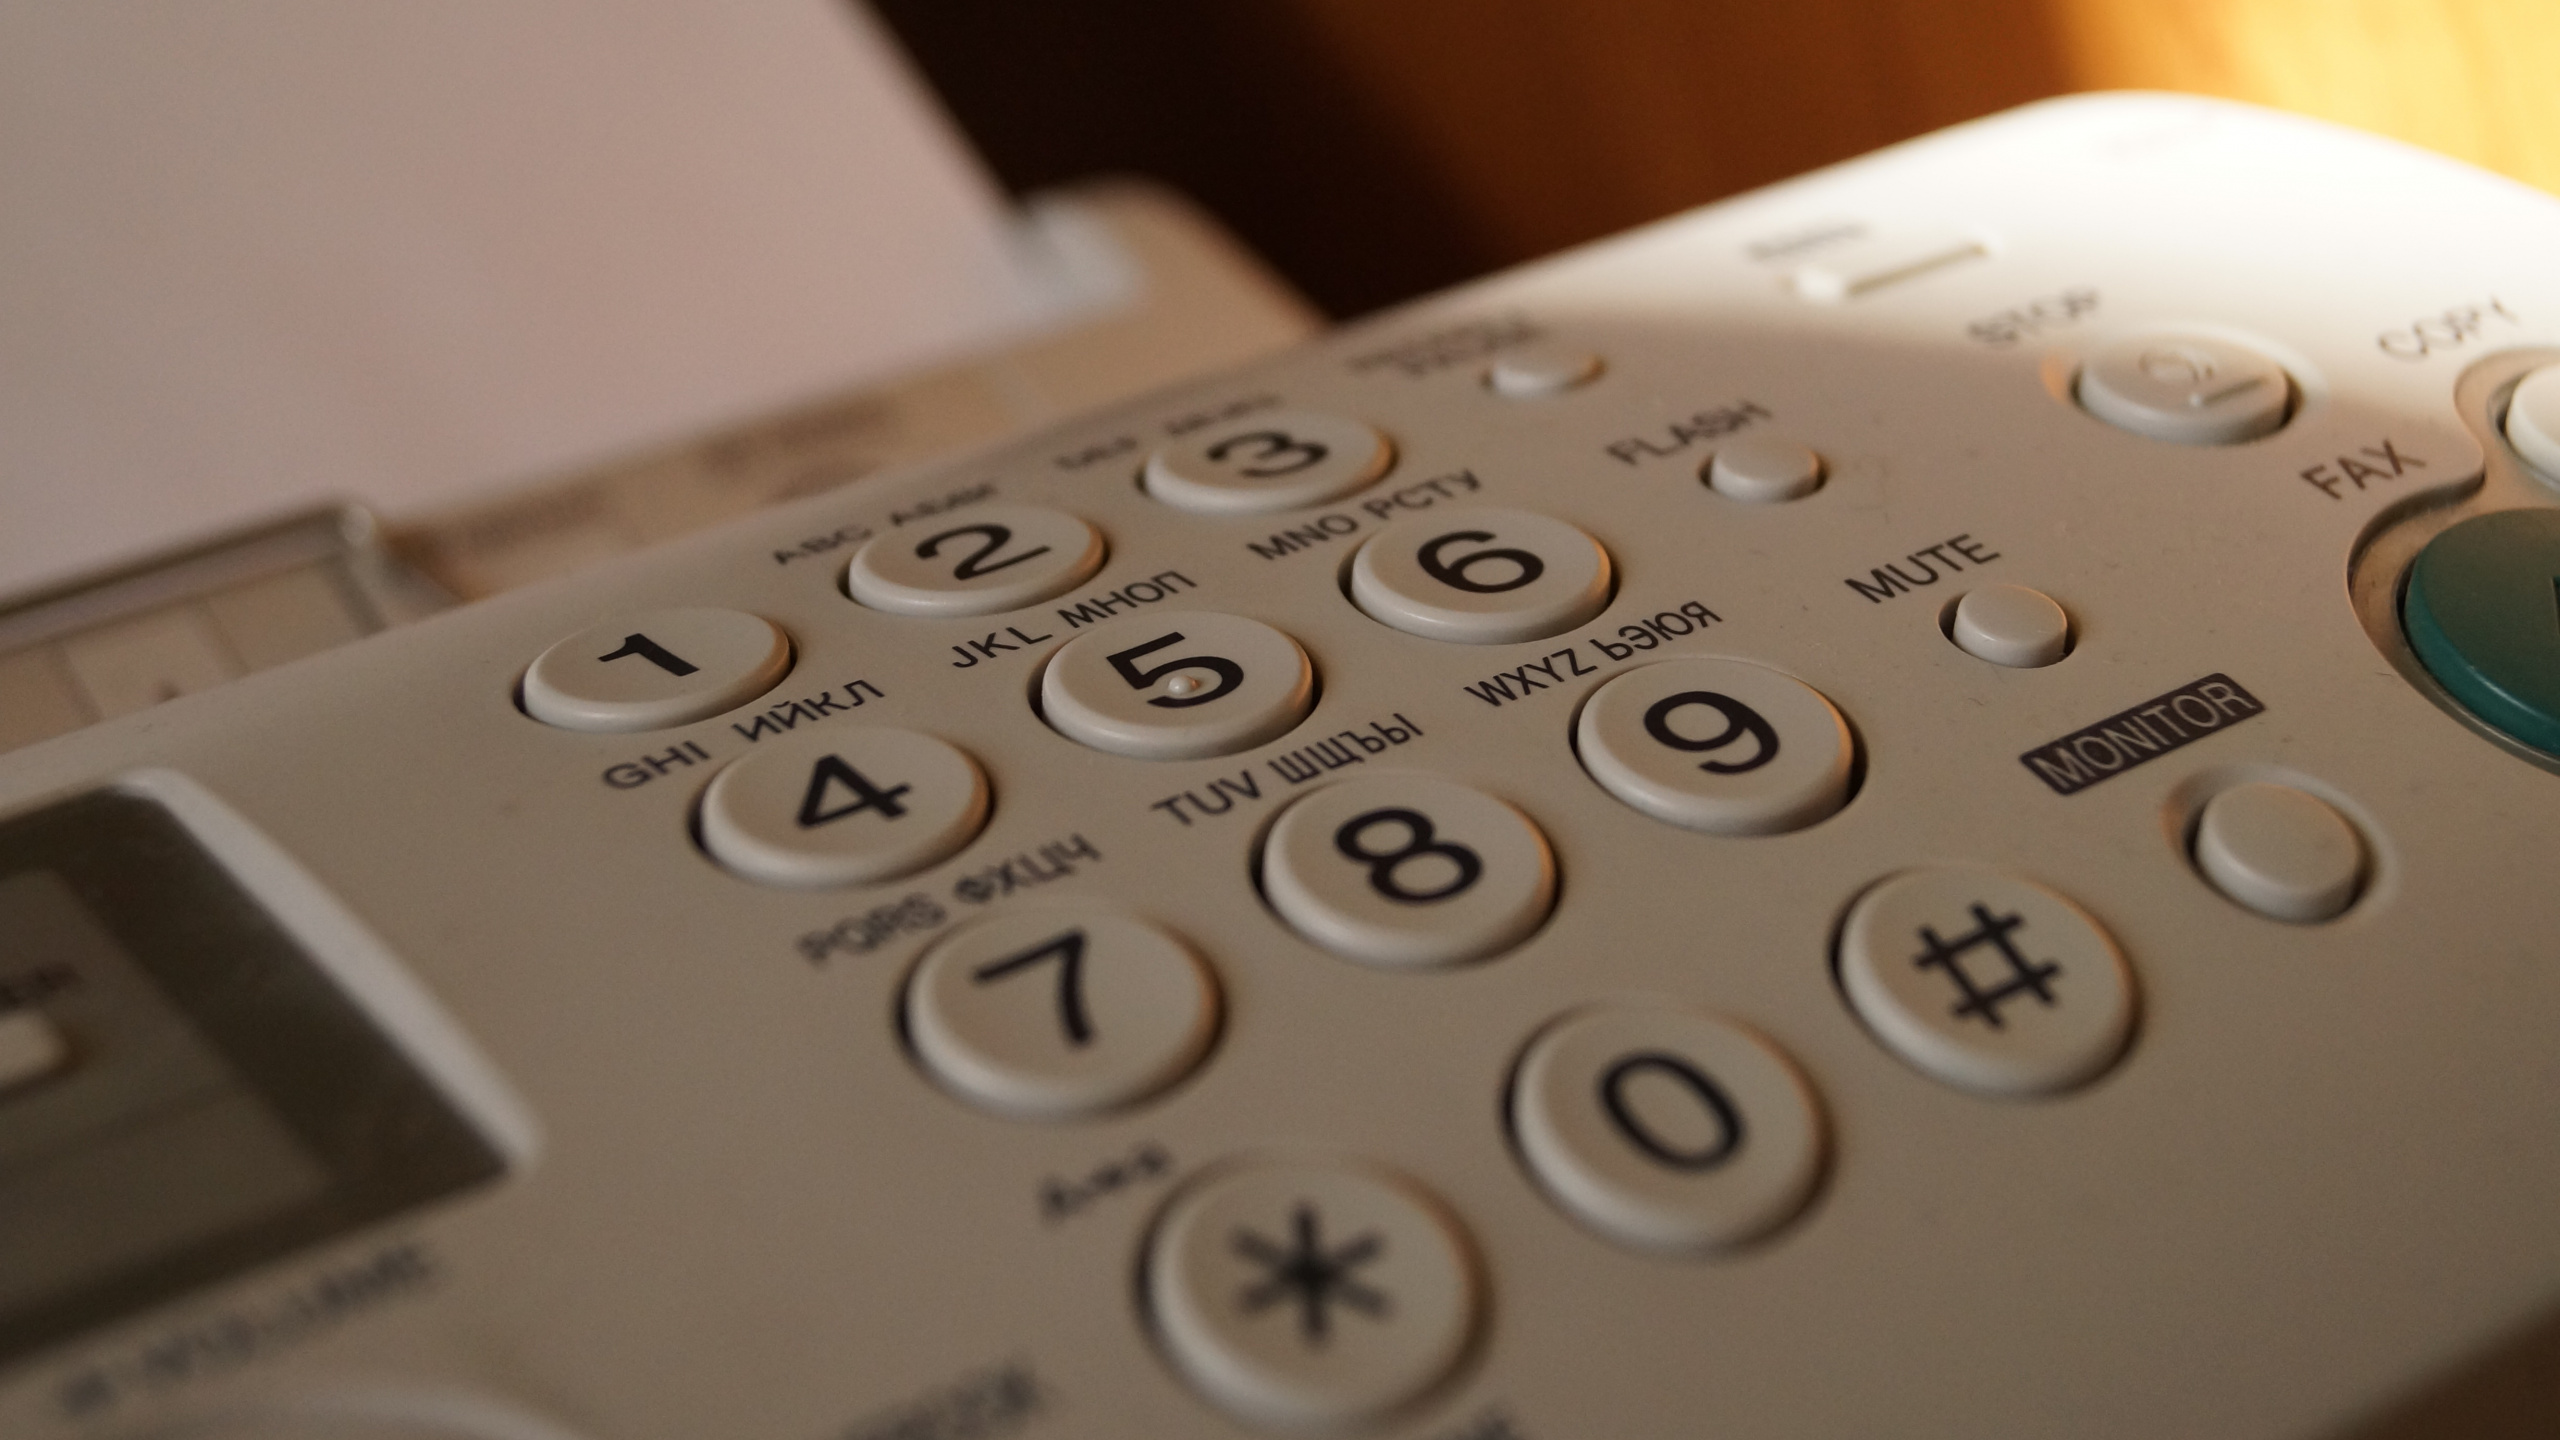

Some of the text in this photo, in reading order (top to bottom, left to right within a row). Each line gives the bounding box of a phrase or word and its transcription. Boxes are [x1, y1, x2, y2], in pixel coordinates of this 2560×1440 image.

[1206, 432, 1328, 479] 3
[2299, 438, 2427, 500] FAX
[915, 524, 1050, 581] 2
[1246, 514, 1358, 561] MNO
[1417, 531, 1544, 594] 6
[1844, 533, 2001, 603] MUTE
[598, 632, 700, 677] 1
[951, 570, 1198, 668] JKL МНОП
[1463, 600, 1723, 707] WXYZ ЬЭЮЯ
[1106, 631, 1244, 709] 5
[602, 679, 885, 789] GHI ИЙКЛ
[1150, 712, 1424, 826] TUV ШЩЪЫ
[1643, 690, 1780, 775] 9
[2031, 682, 2257, 790] MONITOR
[796, 753, 911, 830] 4
[1333, 806, 1484, 908] 8
[973, 929, 1094, 1048] 7
[1595, 1050, 1747, 1175] 0
